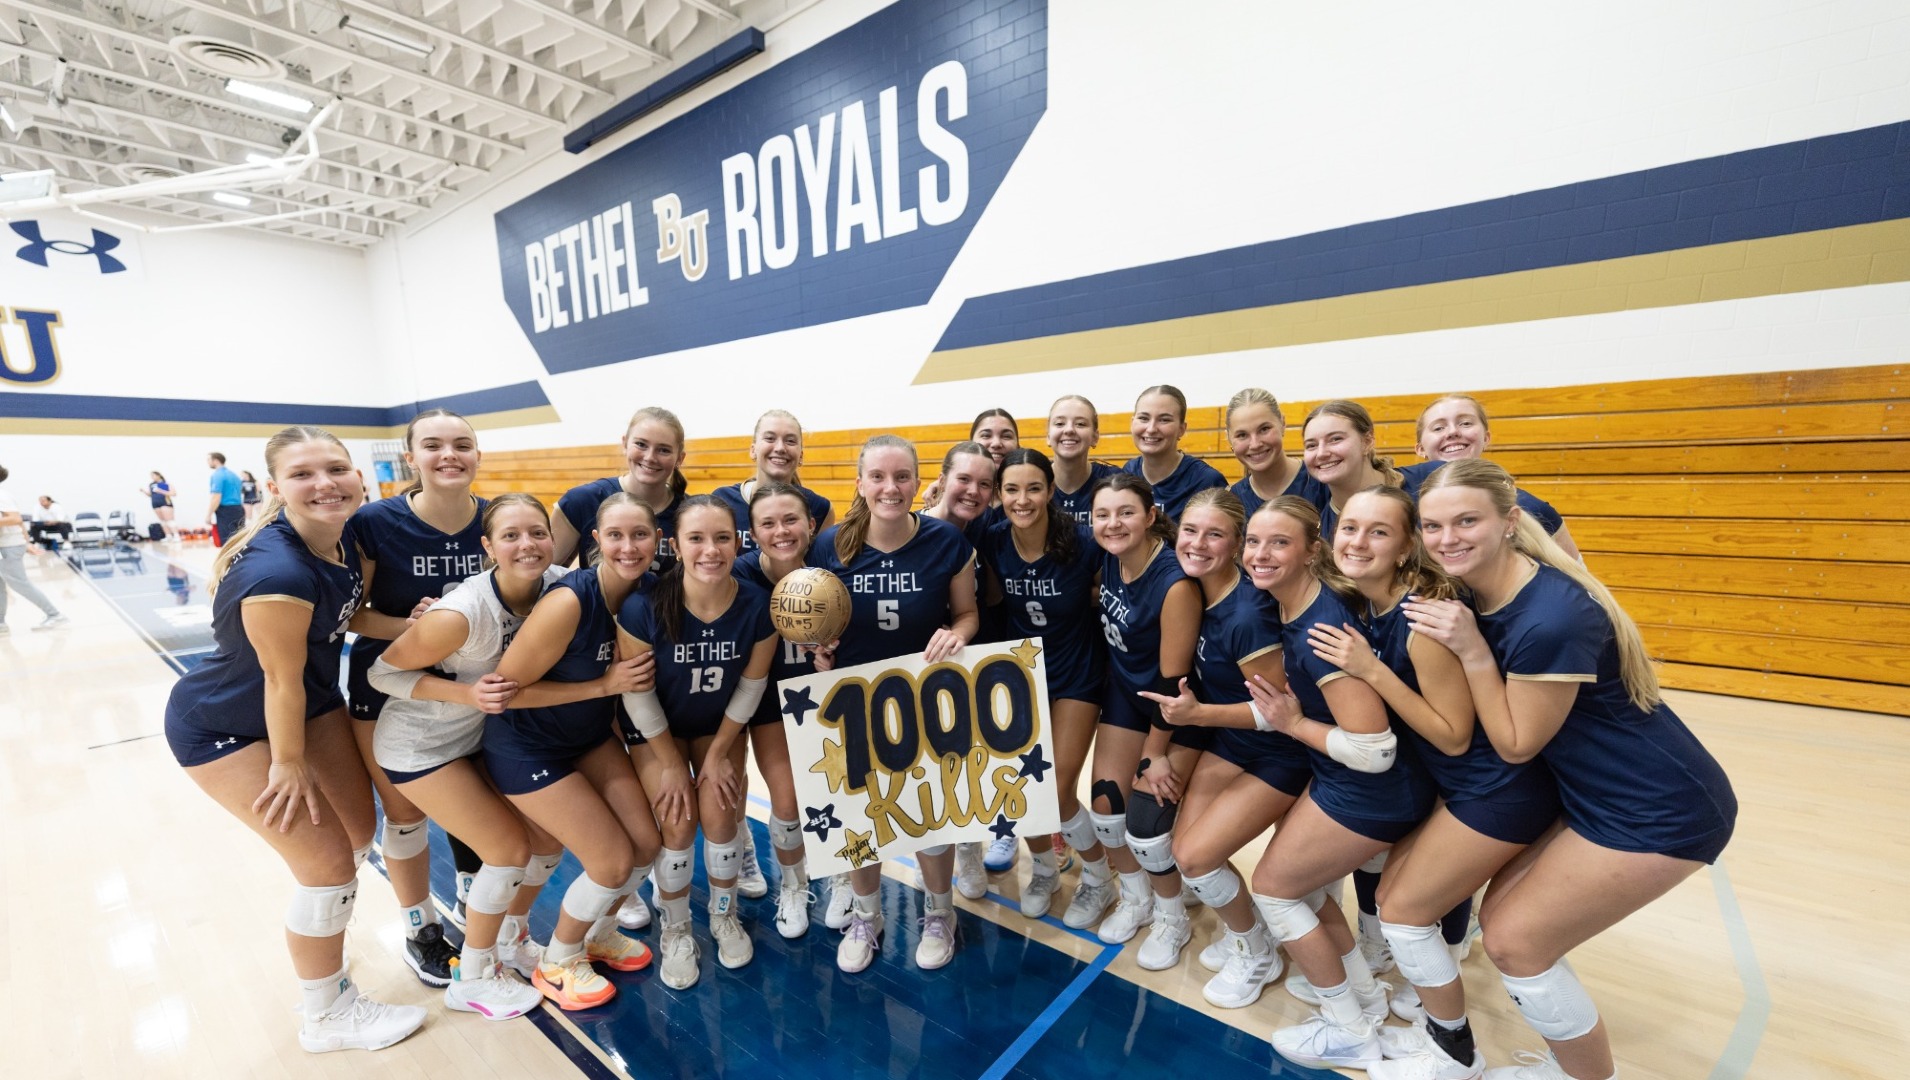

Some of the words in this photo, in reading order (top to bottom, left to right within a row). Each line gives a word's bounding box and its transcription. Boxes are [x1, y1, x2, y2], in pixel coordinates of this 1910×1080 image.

[525, 201, 650, 334] BETHEL
[652, 193, 709, 282] BU
[721, 60, 969, 281] ROYALS
[780, 582, 813, 597] 1,000
[853, 572, 923, 594] BETHEL
[1005, 578, 1062, 597] BETHEL
[779, 597, 813, 614] KILLS
[877, 599, 900, 631] 5
[1099, 584, 1131, 629] BETHEL
[775, 615, 795, 629] FOR
[674, 641, 741, 664] BETHEL
[689, 666, 725, 694] 13
[816, 653, 1041, 796] 1000
[809, 812, 831, 830] #5
